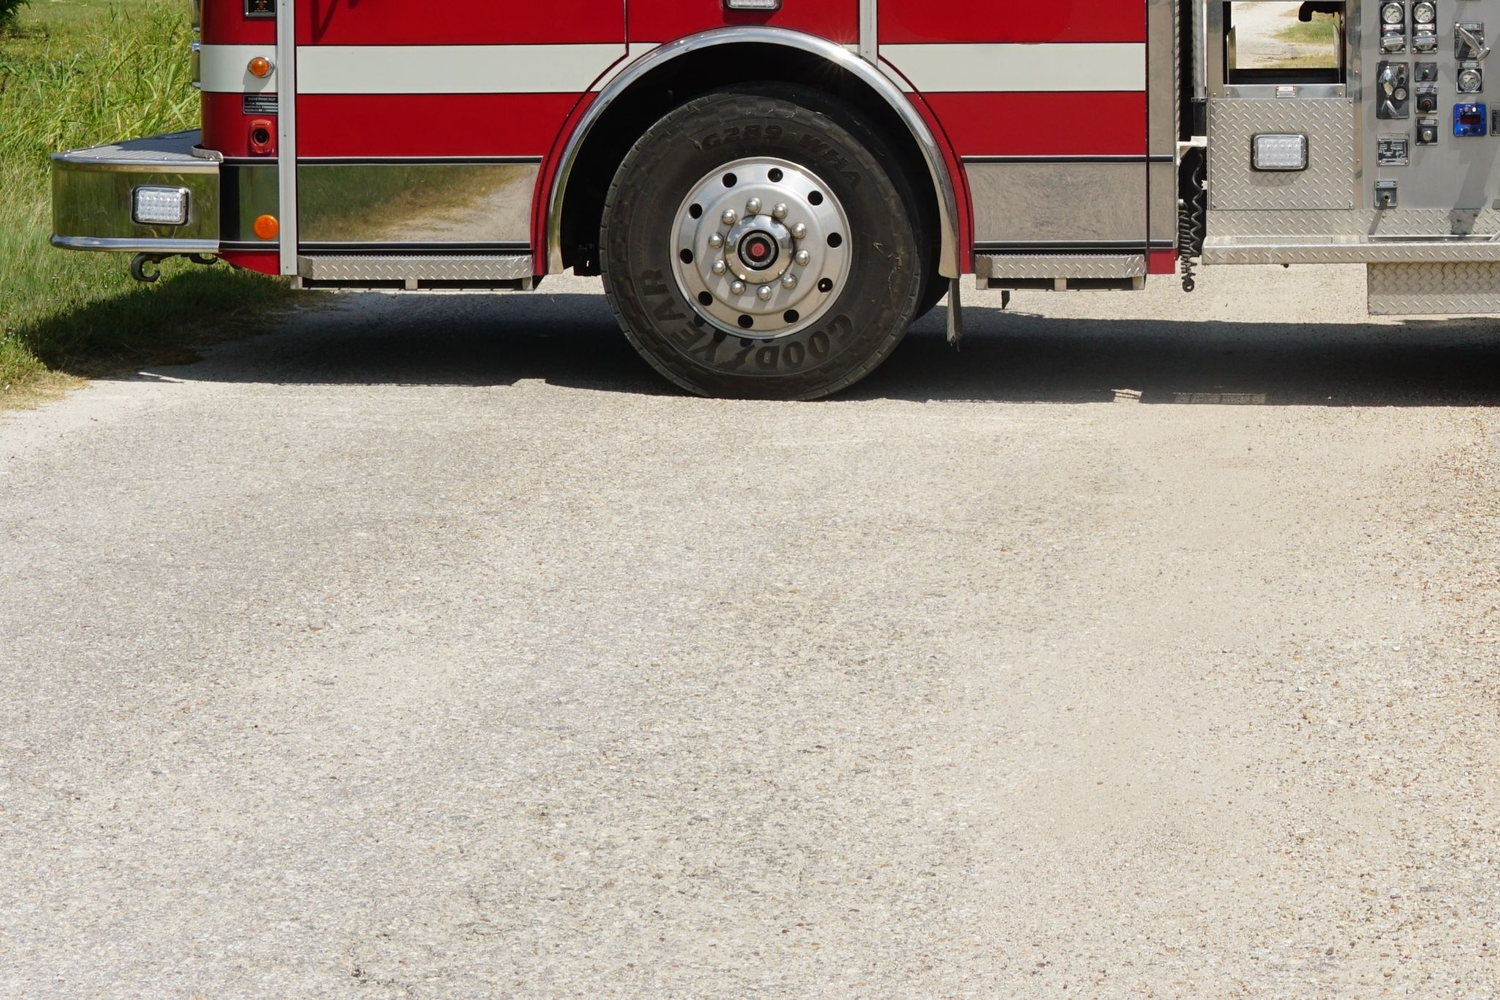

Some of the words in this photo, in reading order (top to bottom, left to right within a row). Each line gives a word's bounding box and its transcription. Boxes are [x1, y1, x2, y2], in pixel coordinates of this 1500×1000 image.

[701, 124, 783, 152] G289
[796, 133, 863, 190] WHA
[639, 269, 854, 373] GOODYEAR
